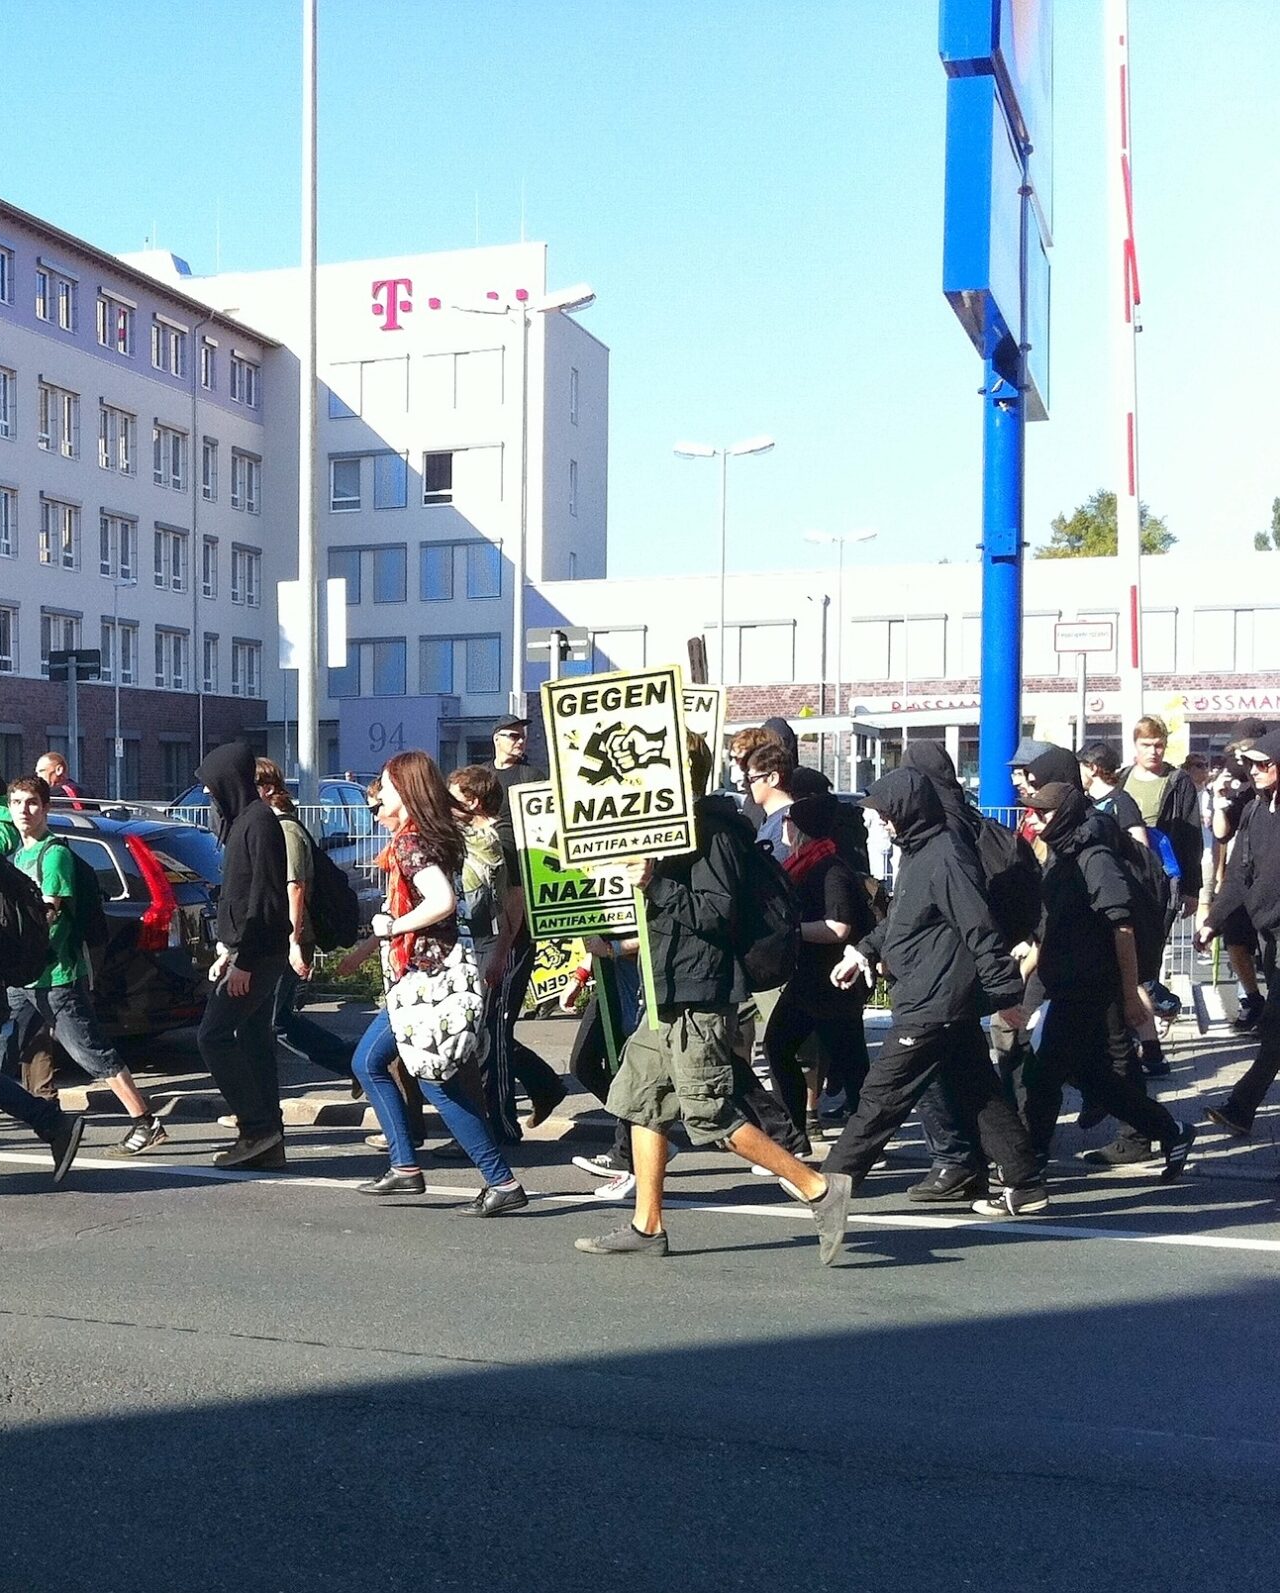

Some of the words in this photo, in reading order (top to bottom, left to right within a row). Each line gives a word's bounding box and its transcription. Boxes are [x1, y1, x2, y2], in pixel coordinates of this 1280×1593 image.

[556, 680, 668, 718] GEGEN
[683, 695, 713, 713] EN
[368, 722, 407, 753] 94
[525, 795, 555, 816] GE
[572, 788, 675, 825] NAZIS
[571, 837, 628, 856] ANTIFA
[642, 830, 685, 846] AREA
[538, 876, 625, 904] NAZIS
[538, 915, 587, 930] ANTIFA
[596, 911, 634, 923] AREA
[537, 974, 569, 995] GEN
